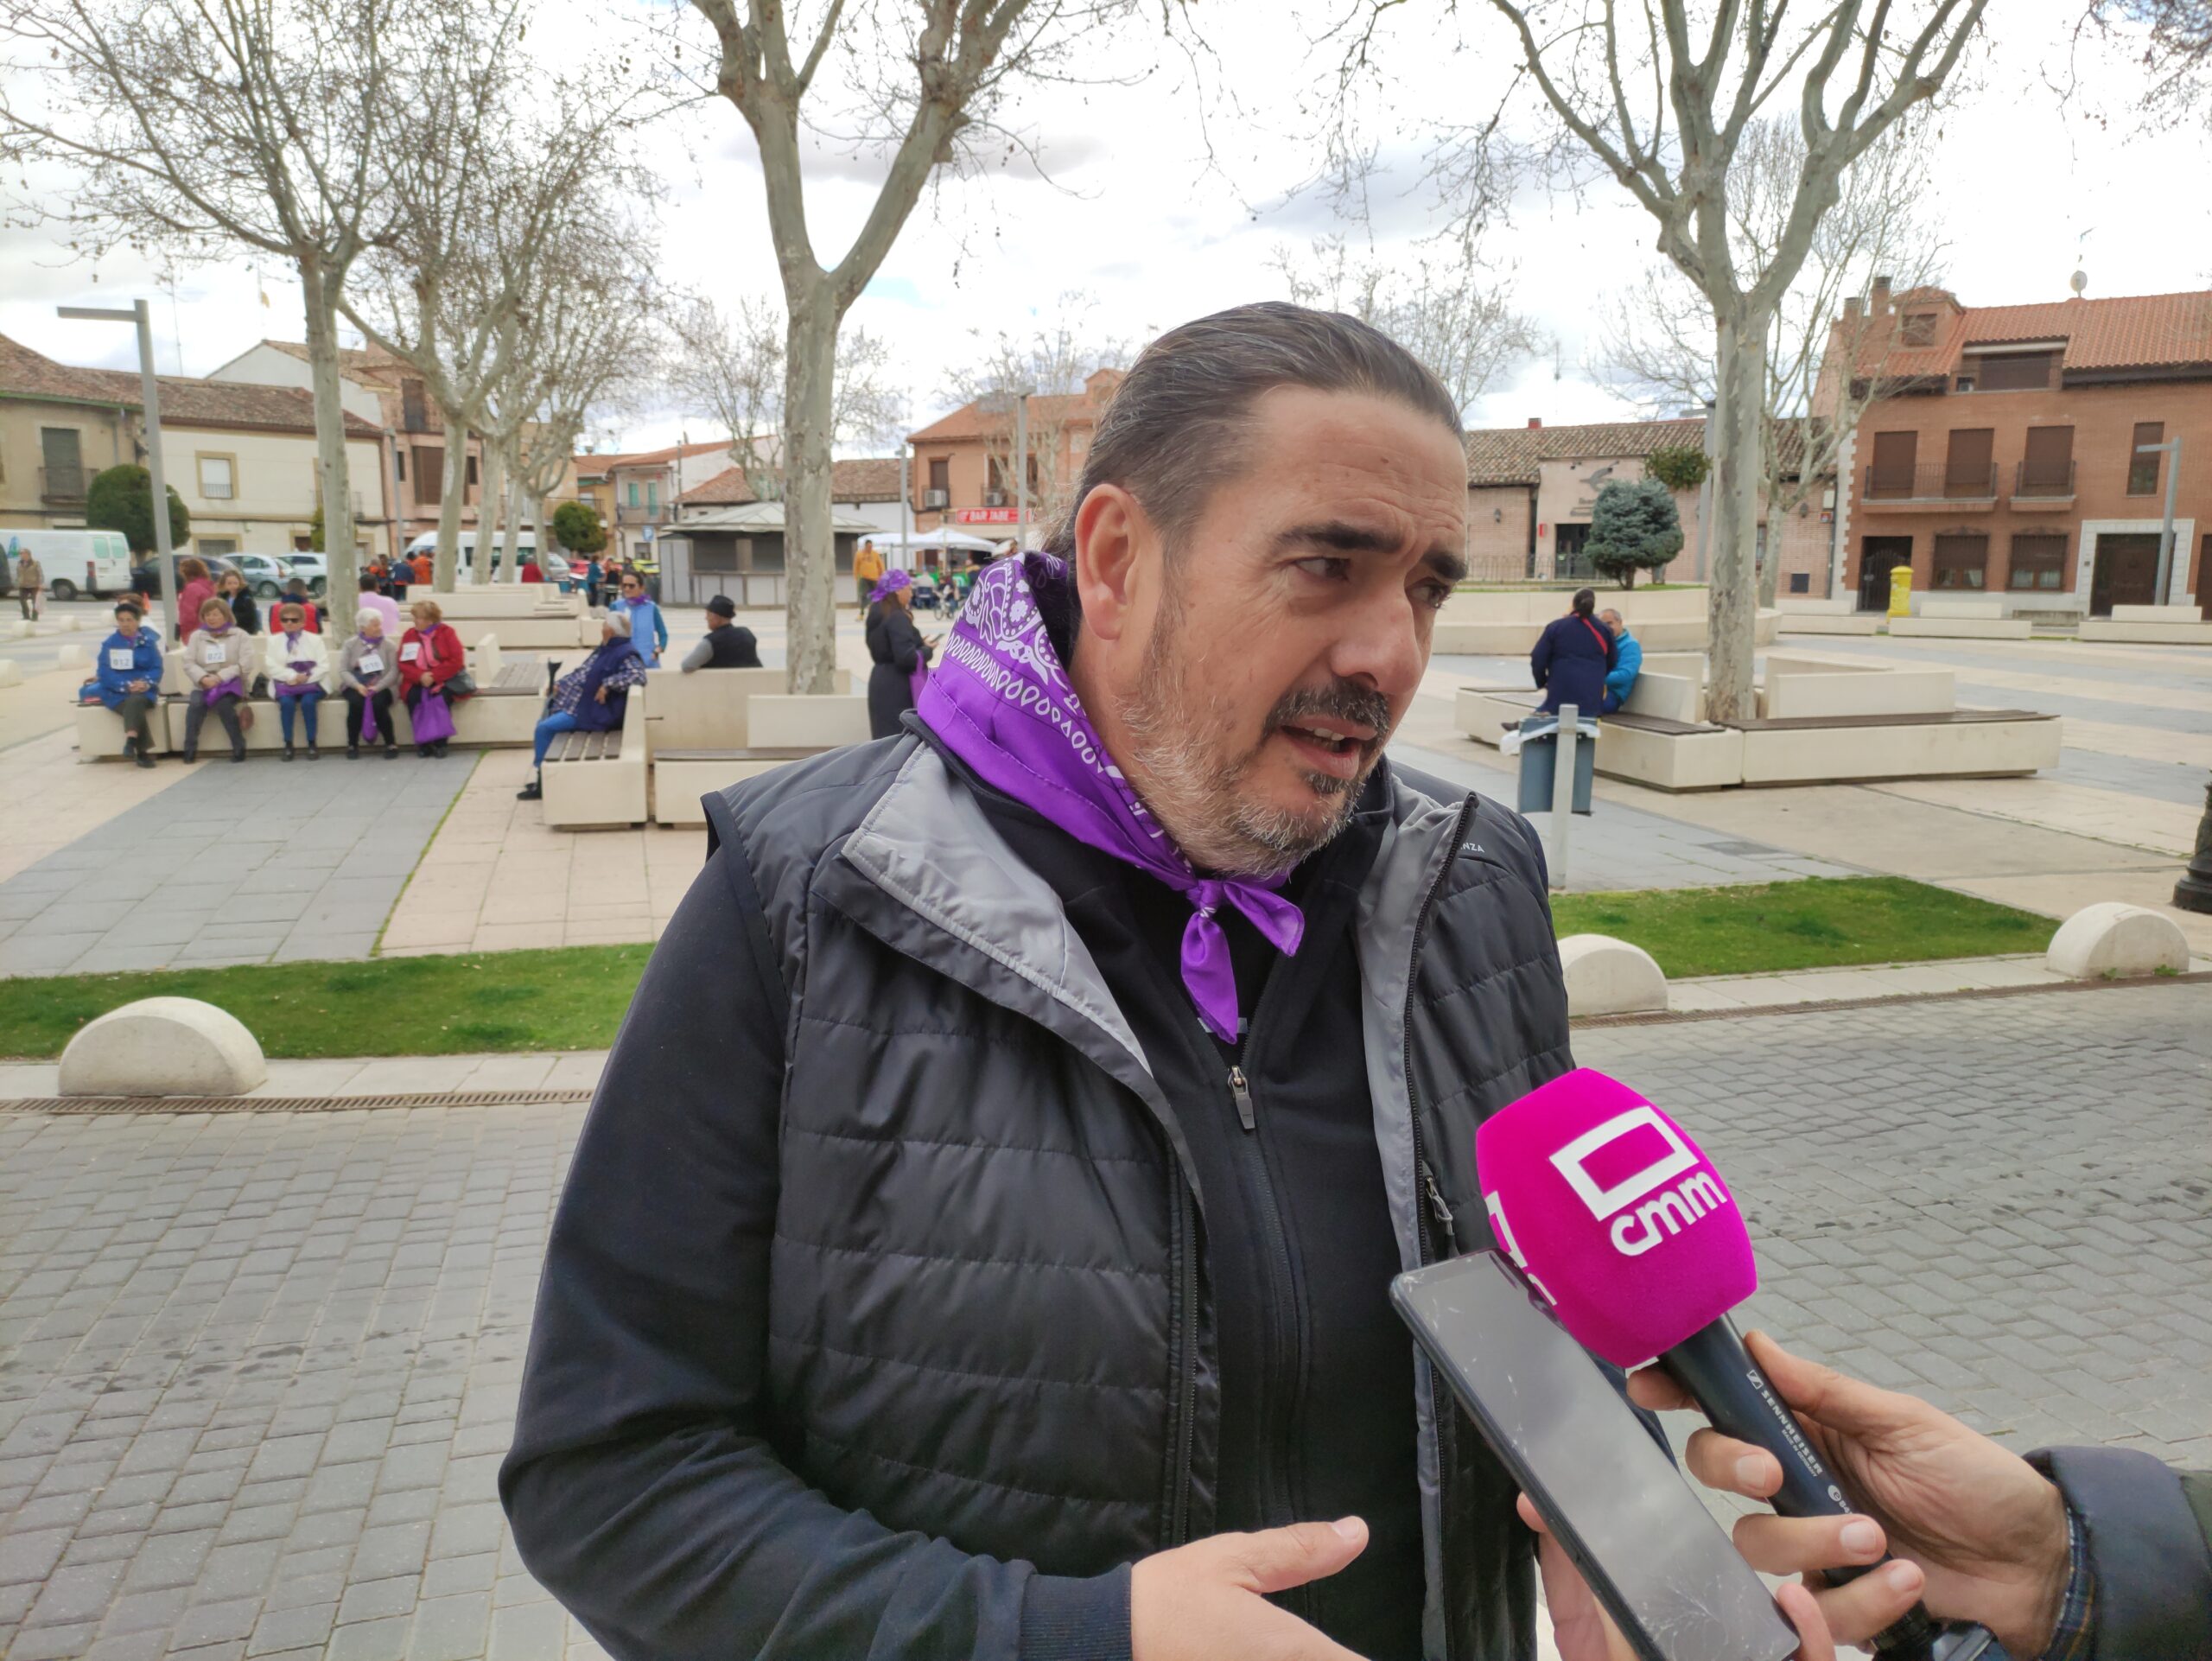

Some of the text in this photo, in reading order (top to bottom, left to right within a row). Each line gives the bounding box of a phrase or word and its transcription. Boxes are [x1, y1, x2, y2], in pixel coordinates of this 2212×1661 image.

[1460, 842, 1485, 853] NZA
[1610, 1170, 1727, 1257] cmm
[1761, 1390, 1823, 1474] SENNHEISER
[1781, 1429, 1794, 1446] MADE
[1796, 1450, 1818, 1477] GERMANY
[1839, 1499, 1853, 1514] 84
